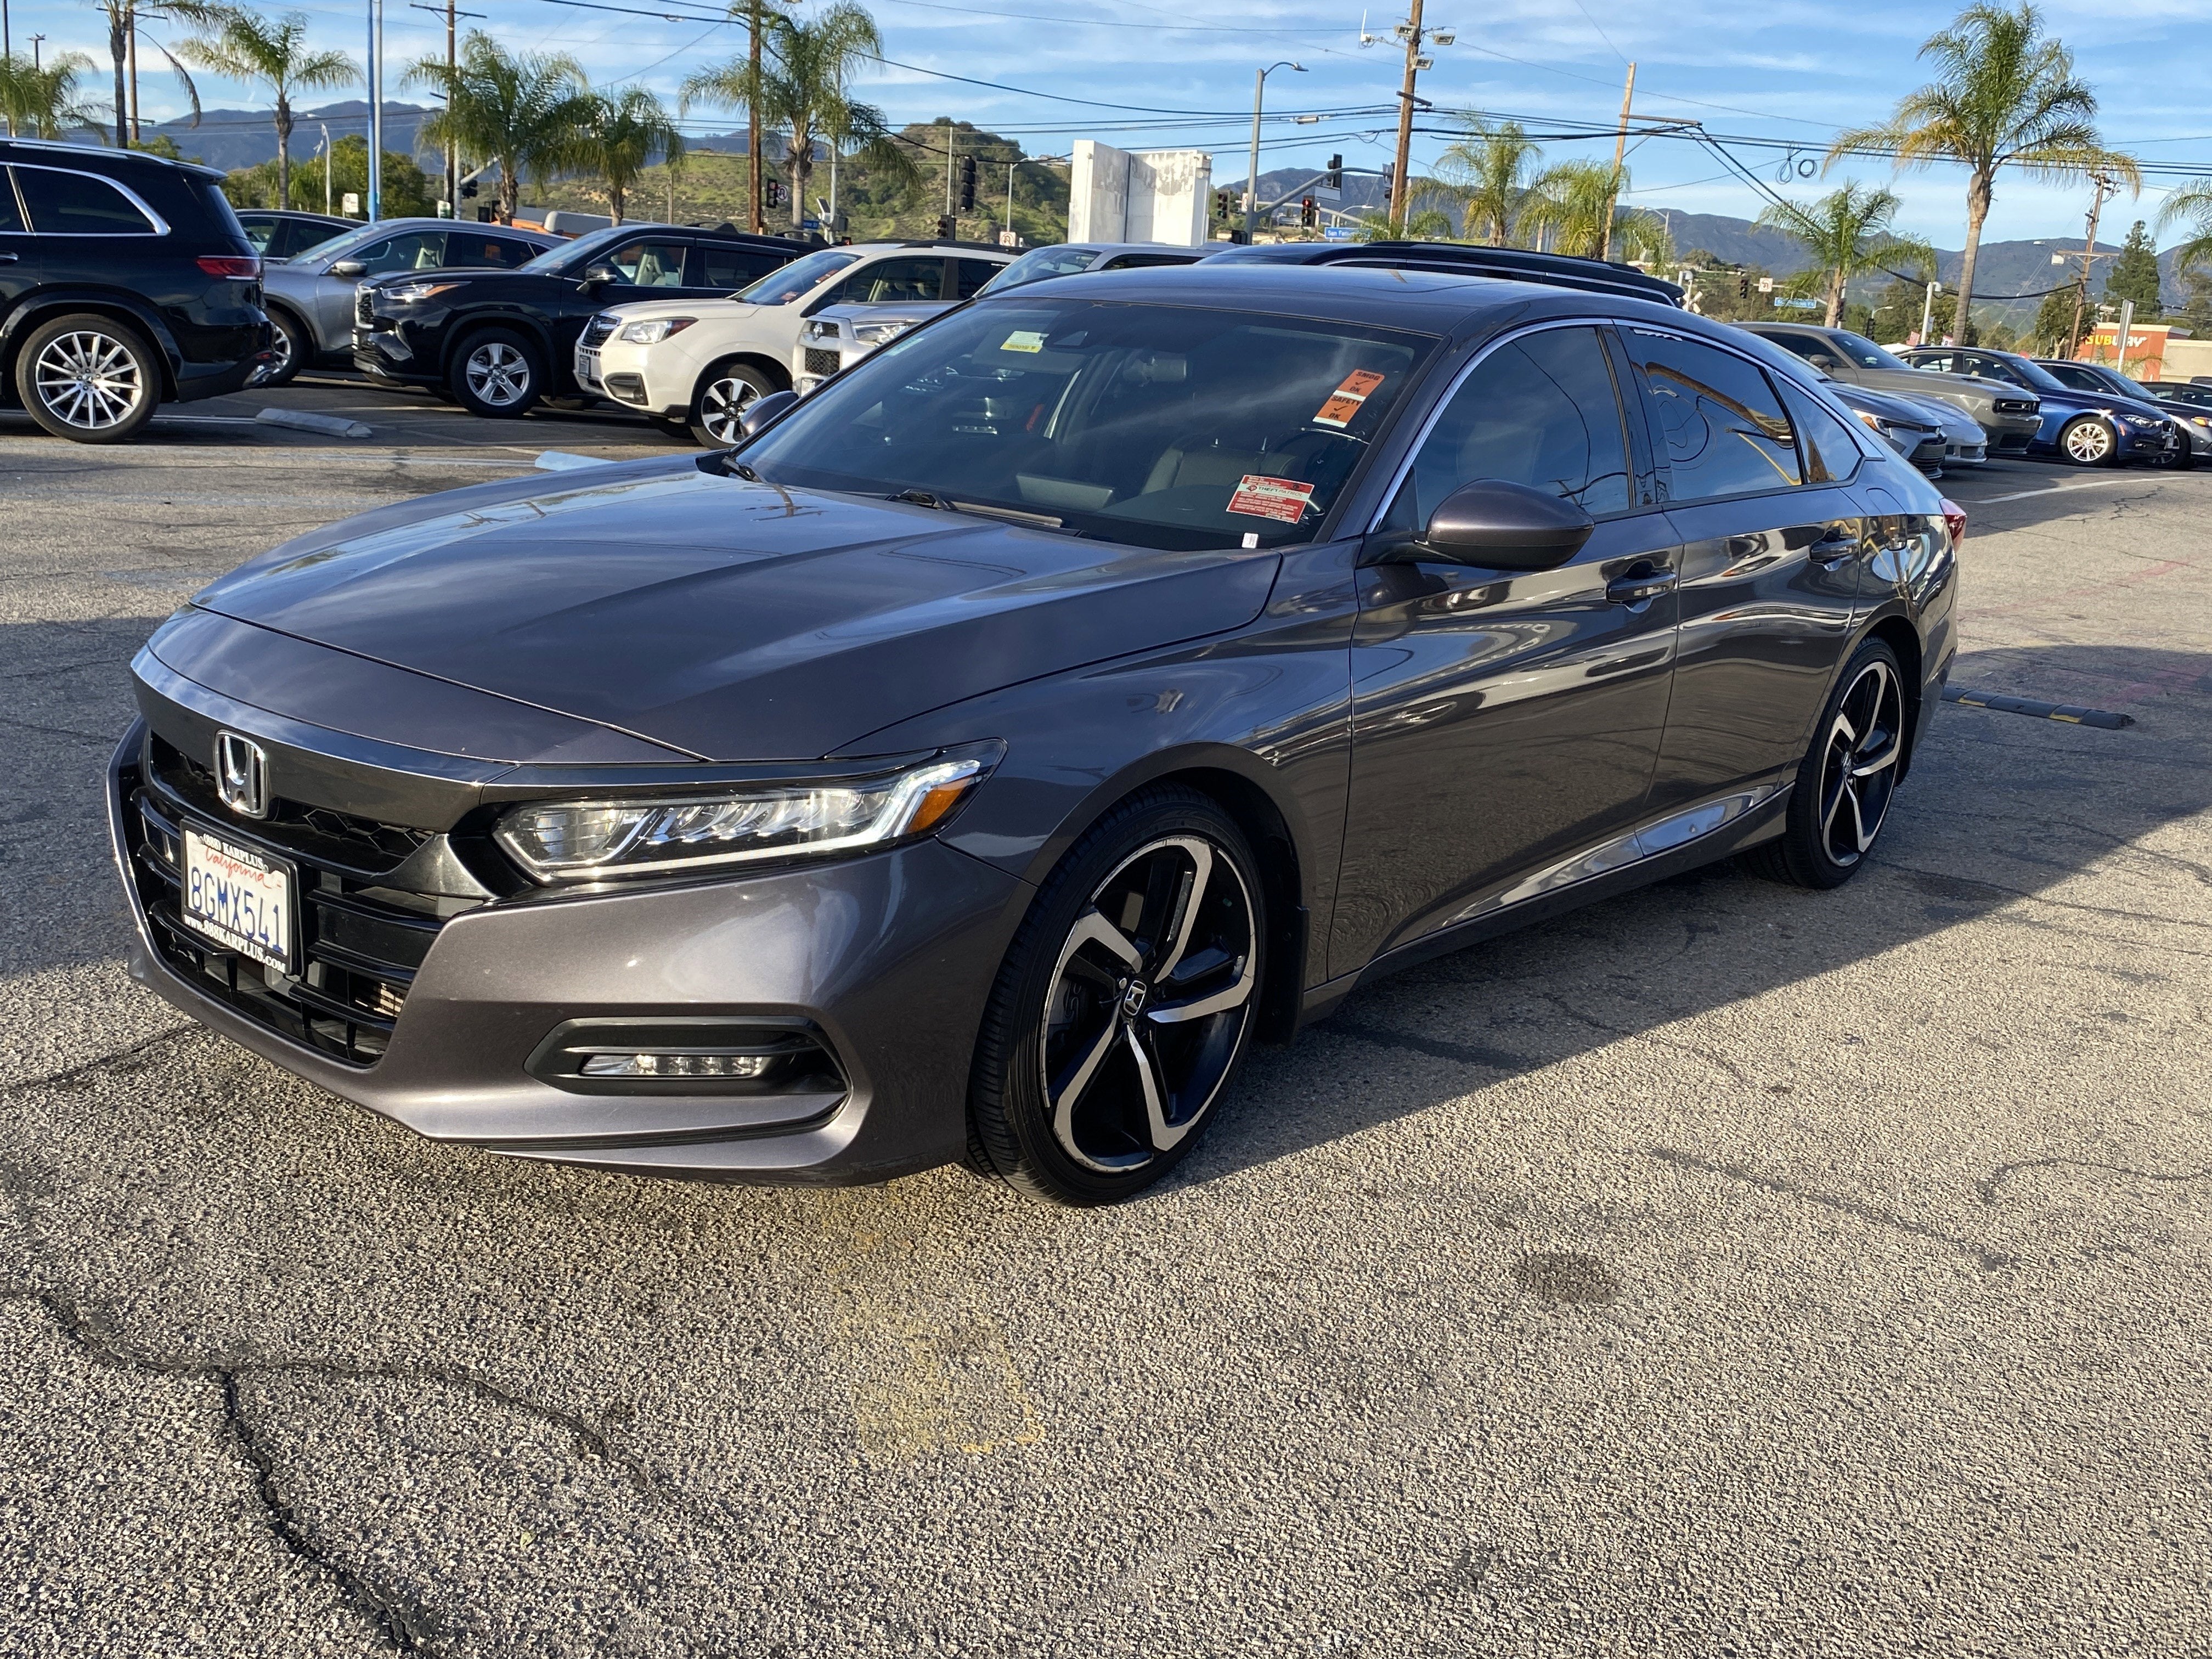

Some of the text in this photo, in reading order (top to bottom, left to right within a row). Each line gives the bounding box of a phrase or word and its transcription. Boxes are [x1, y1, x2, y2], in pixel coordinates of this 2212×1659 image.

[1356, 371, 1380, 381] SMOG
[1331, 396, 1362, 406] SAFETY
[206, 847, 272, 889] California
[222, 841, 263, 868] KARPLUS
[191, 866, 283, 954] 8GMX541
